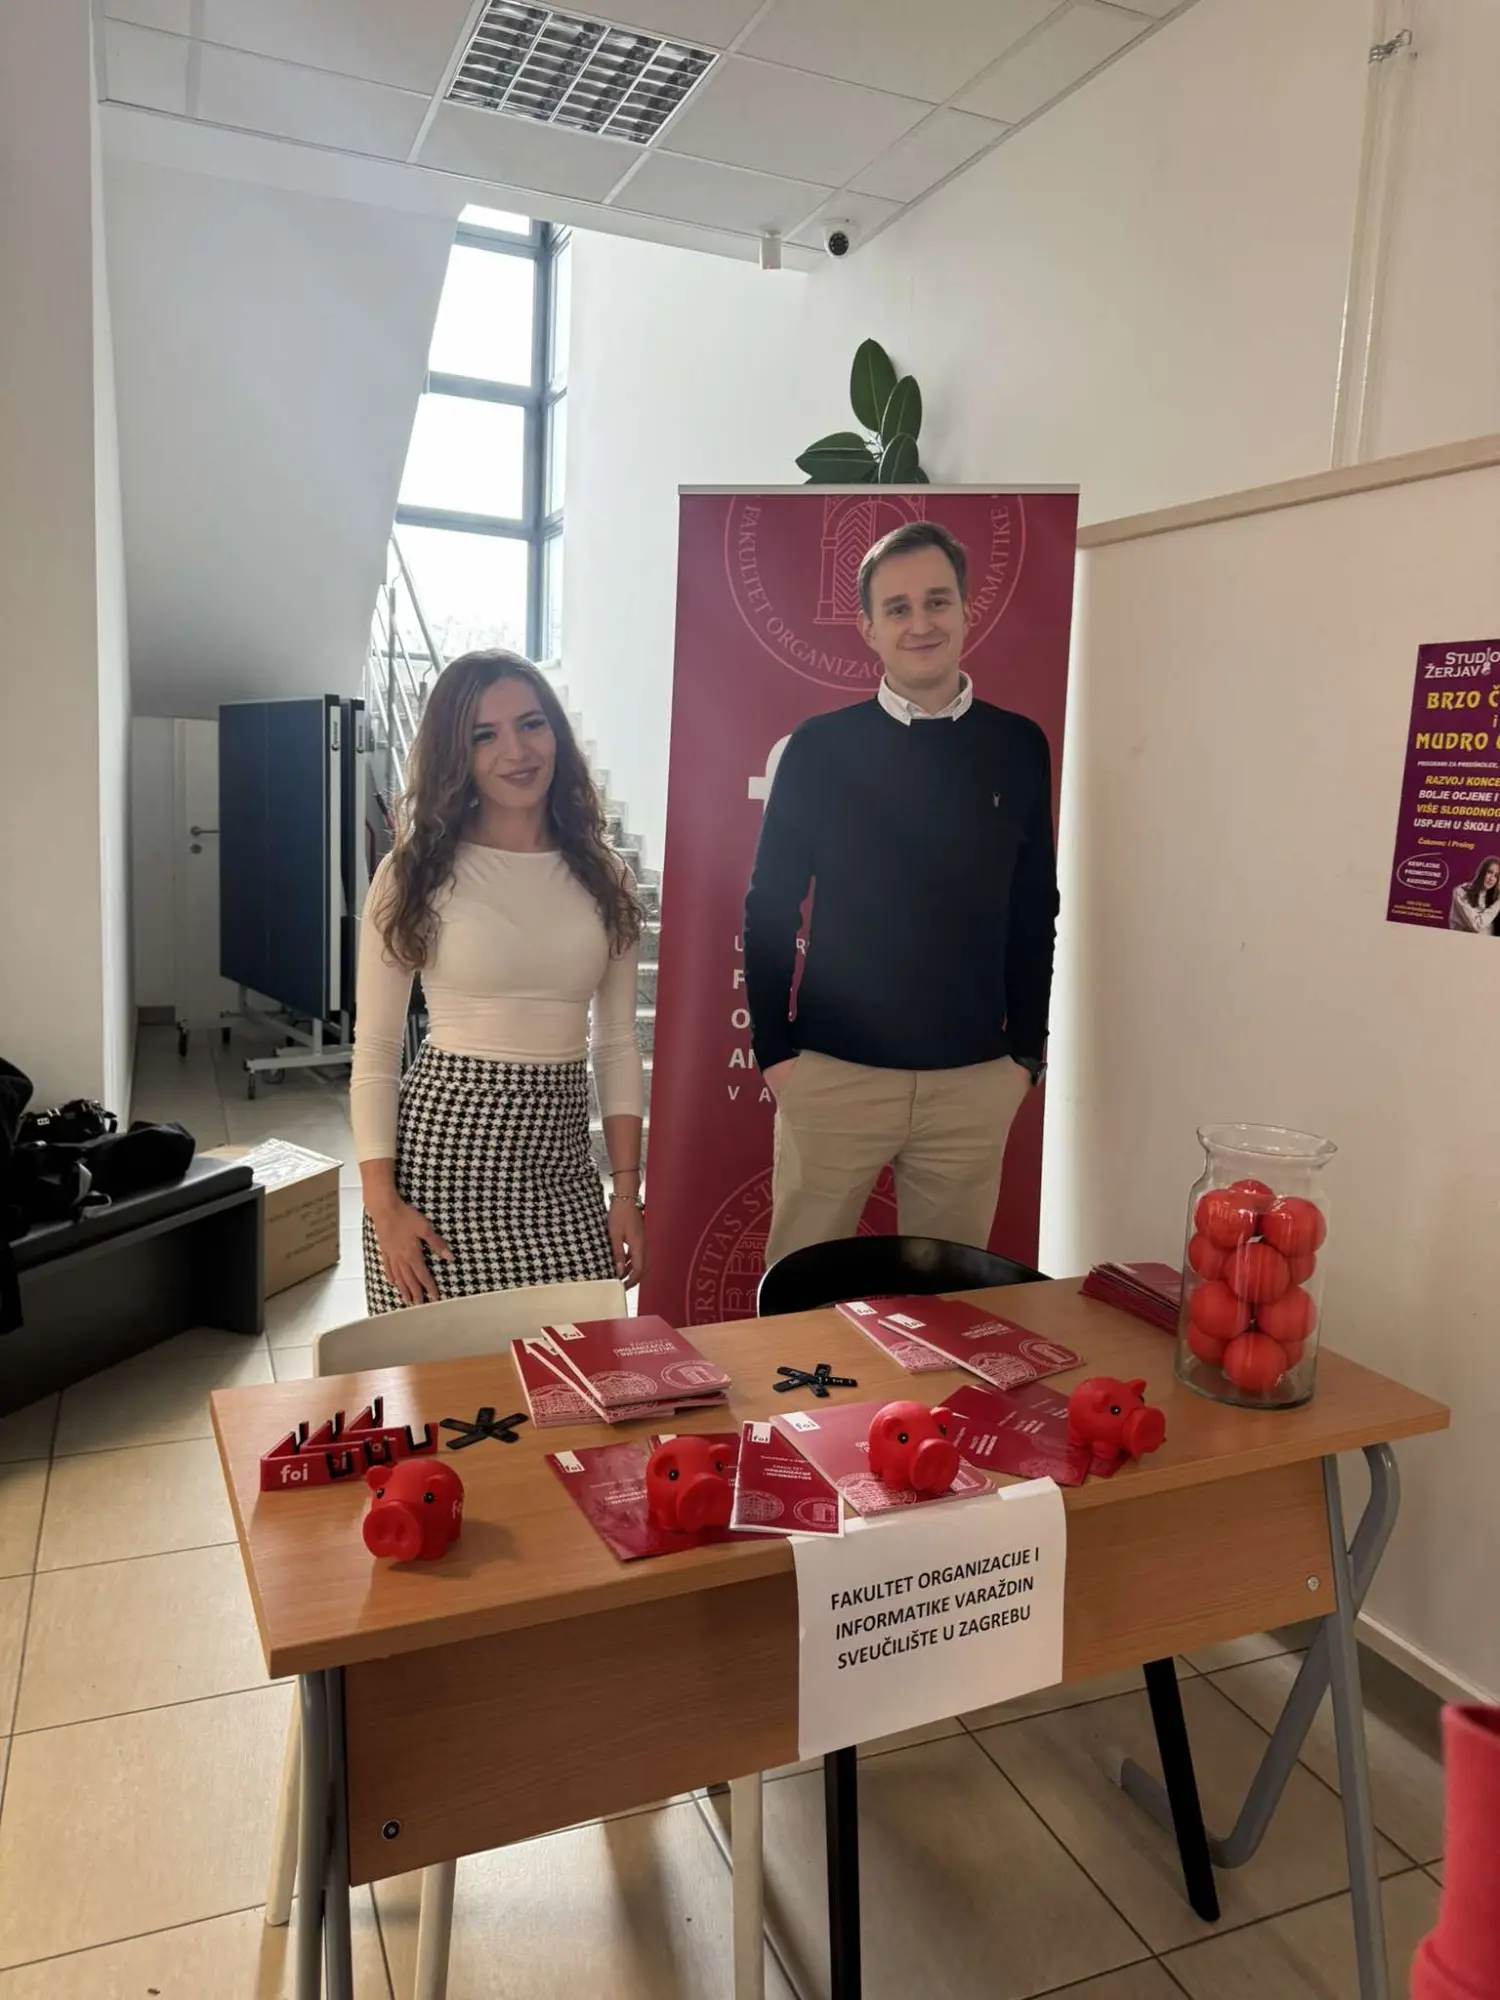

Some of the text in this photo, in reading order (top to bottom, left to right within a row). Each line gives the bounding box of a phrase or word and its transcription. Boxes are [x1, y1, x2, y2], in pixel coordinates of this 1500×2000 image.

[967, 505, 1010, 627] ORMATIKE
[738, 505, 771, 615] FAKULTET
[766, 616, 885, 680] ORGANIZAC
[1424, 663, 1481, 678] ŽERJAV
[1427, 690, 1481, 710] BRZO
[1415, 732, 1489, 751] MUDRO
[1425, 775, 1500, 787] RAZVOJ KONCE
[1419, 789, 1451, 799] BOLJE
[1452, 791, 1493, 802] OCJENE
[1416, 802, 1439, 814] VIŠE
[1413, 818, 1451, 829] USPJEH
[1453, 820, 1461, 830] U
[1463, 819, 1493, 832] ŠKOLI
[280, 1463, 308, 1483] foi
[831, 1547, 1040, 1611] FAKULTET ORGANIZACIJE I
[835, 1576, 1034, 1640] INFORMATIKE VARAŽDIN
[837, 1605, 1031, 1669] SVEUČILIŠTE U ZAGREBU
